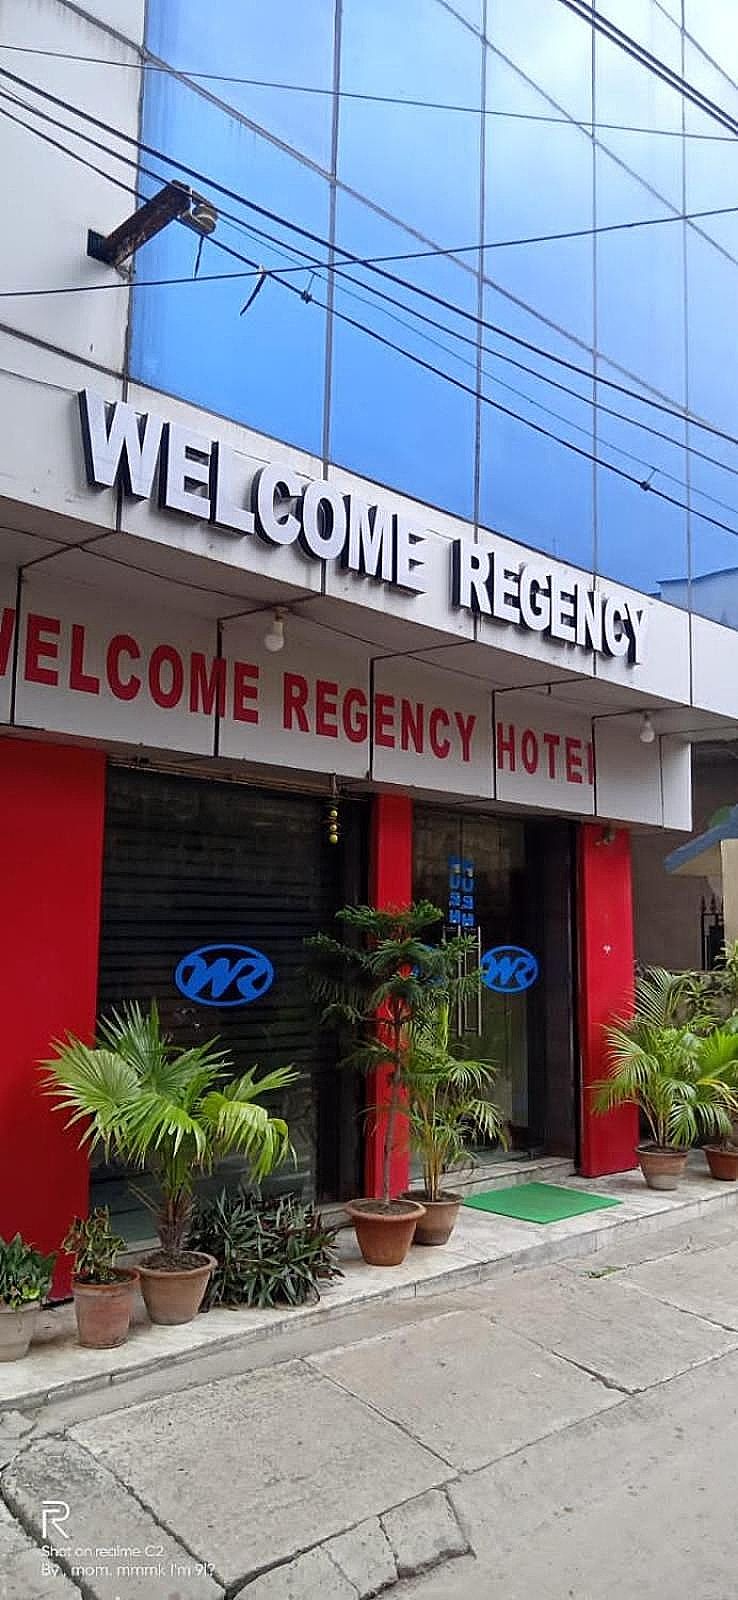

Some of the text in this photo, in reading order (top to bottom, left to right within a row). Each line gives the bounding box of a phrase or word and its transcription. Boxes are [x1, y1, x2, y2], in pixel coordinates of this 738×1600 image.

[79, 388, 648, 664] WELCOME REGENCY
[283, 671, 477, 762] REGENCY
